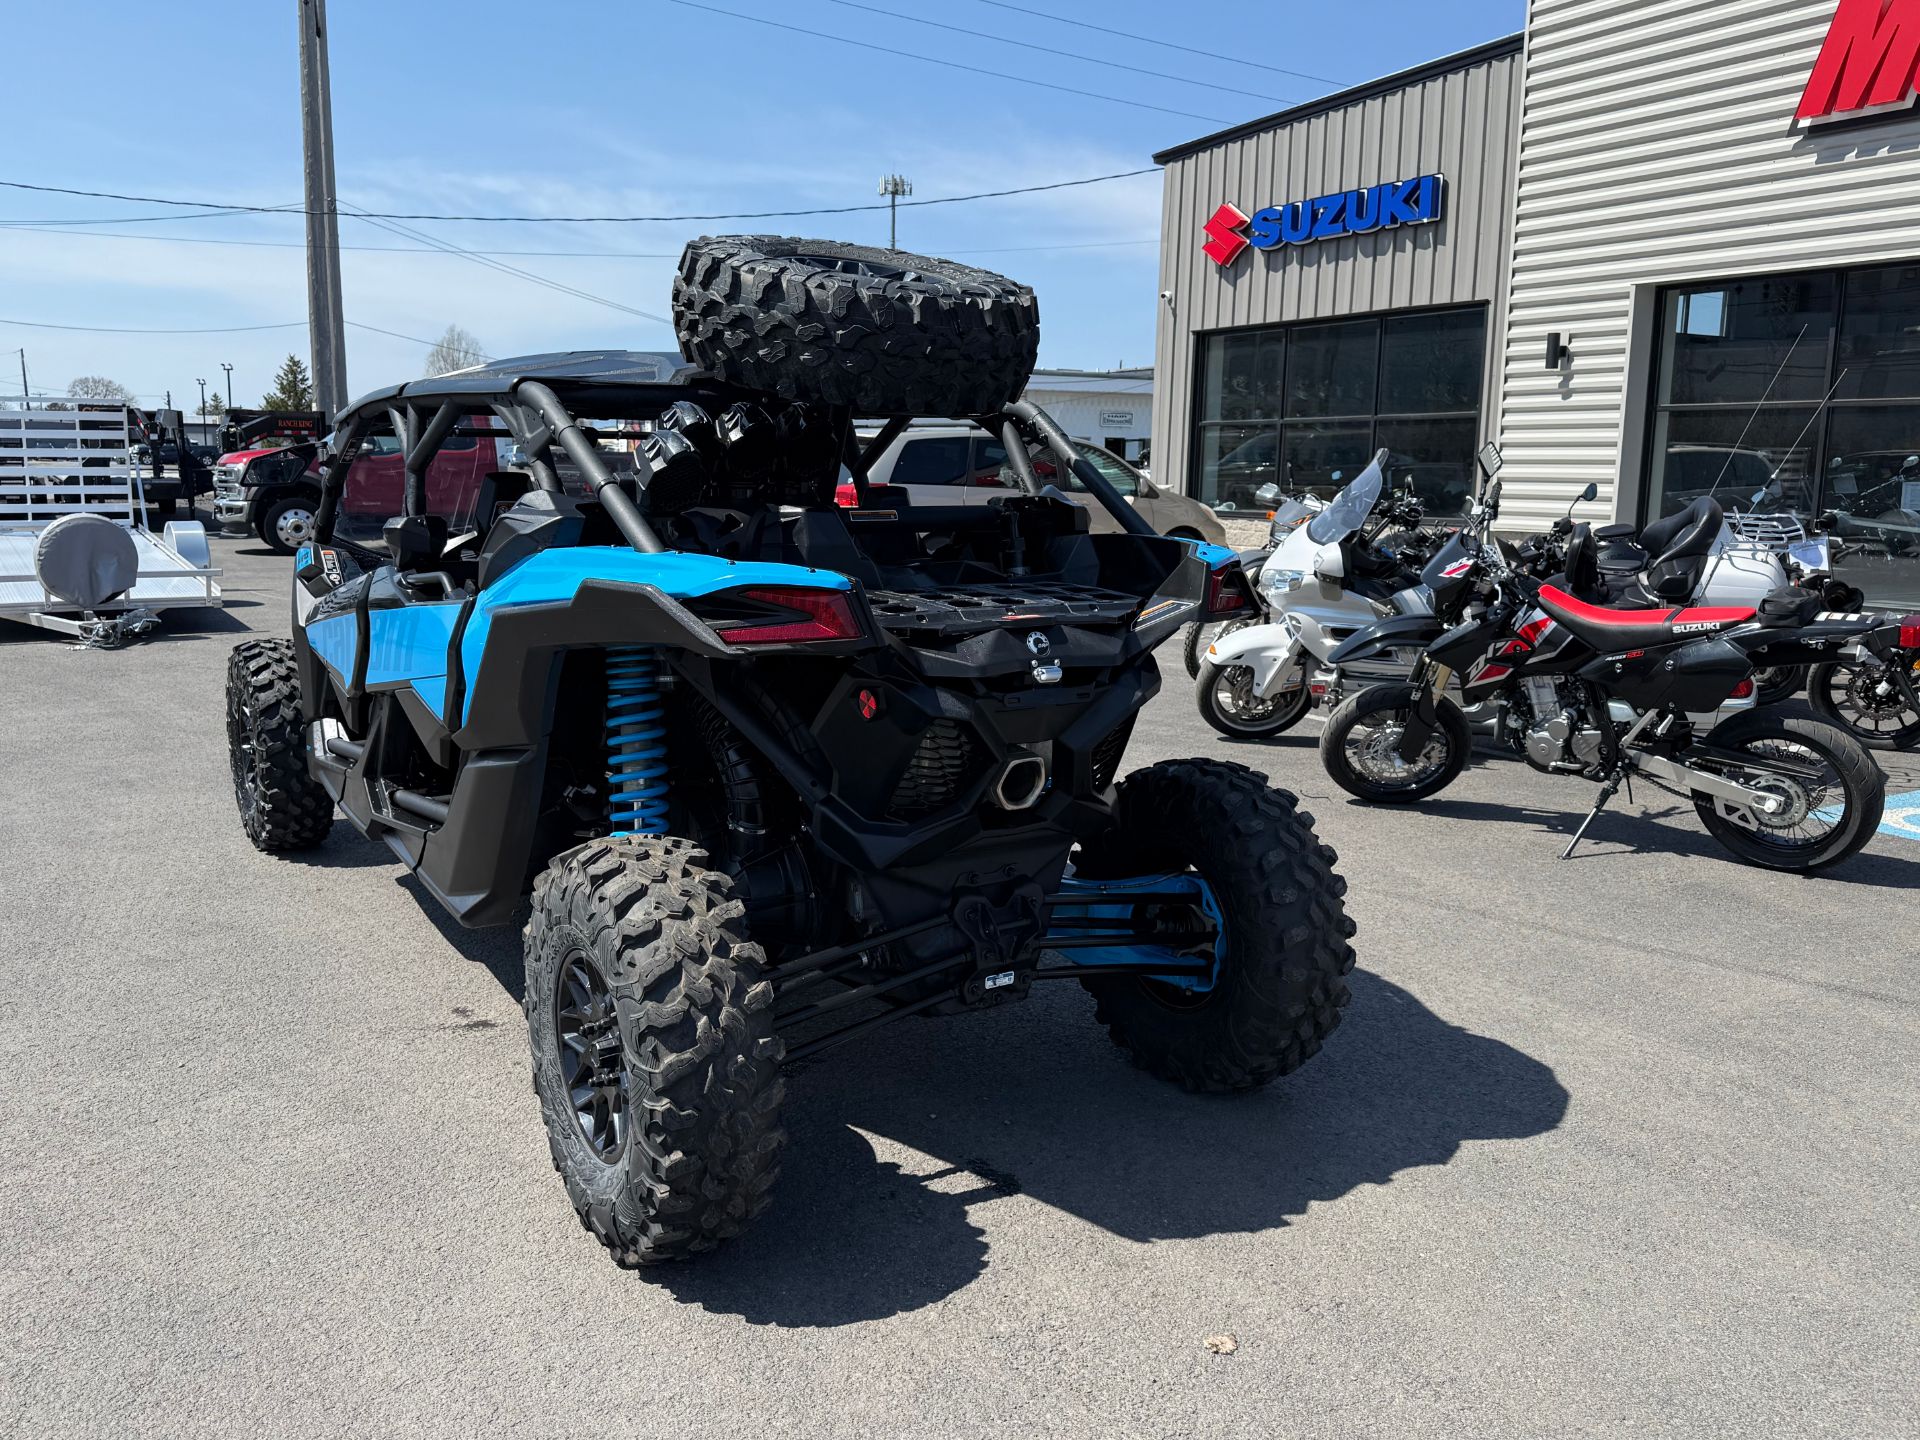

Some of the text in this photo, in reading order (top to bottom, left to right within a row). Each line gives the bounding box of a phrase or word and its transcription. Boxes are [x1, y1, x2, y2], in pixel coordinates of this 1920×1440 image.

[1793, 0, 1920, 120] M
[1250, 174, 1437, 249] SUZUKI
[1672, 622, 1720, 633] SUZUKI
